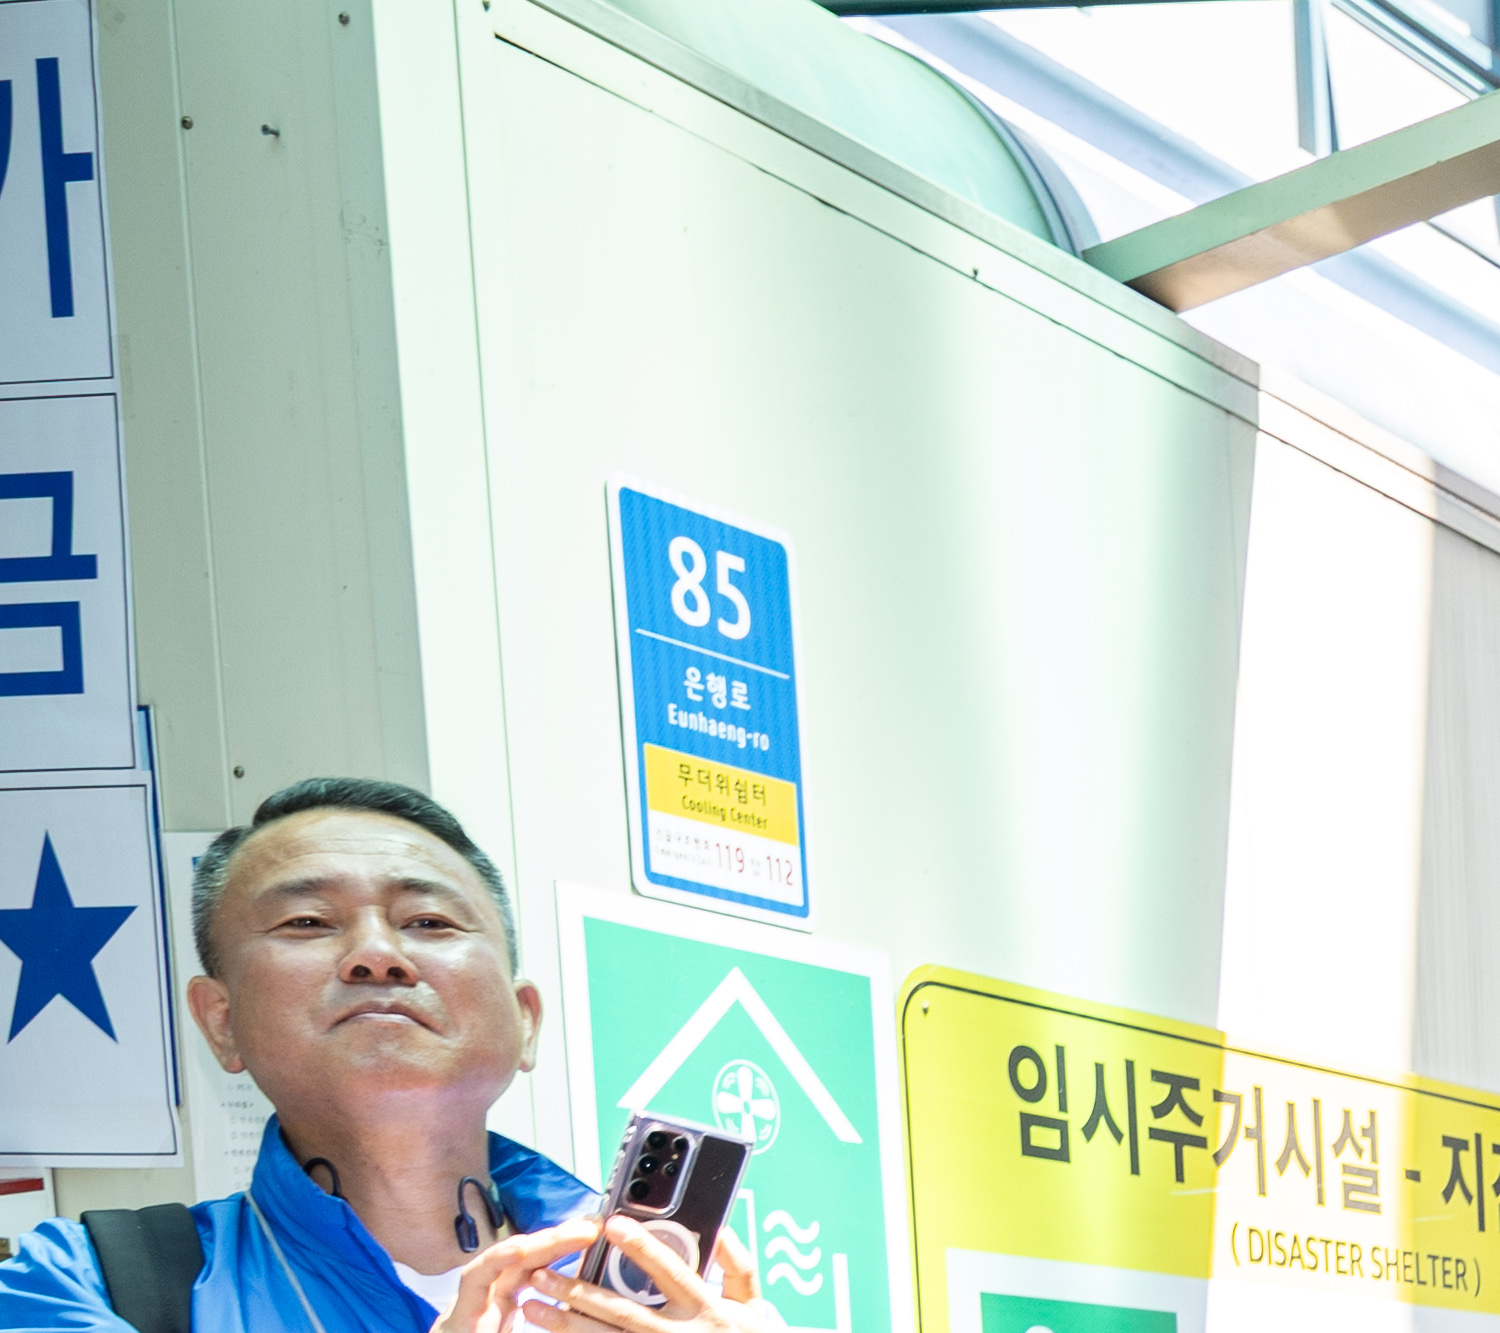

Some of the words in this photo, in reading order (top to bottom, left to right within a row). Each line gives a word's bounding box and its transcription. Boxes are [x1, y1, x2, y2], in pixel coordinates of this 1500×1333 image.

[668, 536, 751, 640] 85
[683, 666, 752, 710] 은행로
[667, 703, 770, 751] Eunhaeng-ro
[677, 763, 767, 807] 무더위쉼터
[681, 794, 727, 822] Cooling
[730, 807, 768, 830] Center
[715, 843, 745, 873] 119
[766, 855, 794, 886] 112
[1007, 1043, 1383, 1215] 임시주거시설
[1248, 1228, 1363, 1278] DISASTER
[1371, 1246, 1468, 1293] SHELTER
